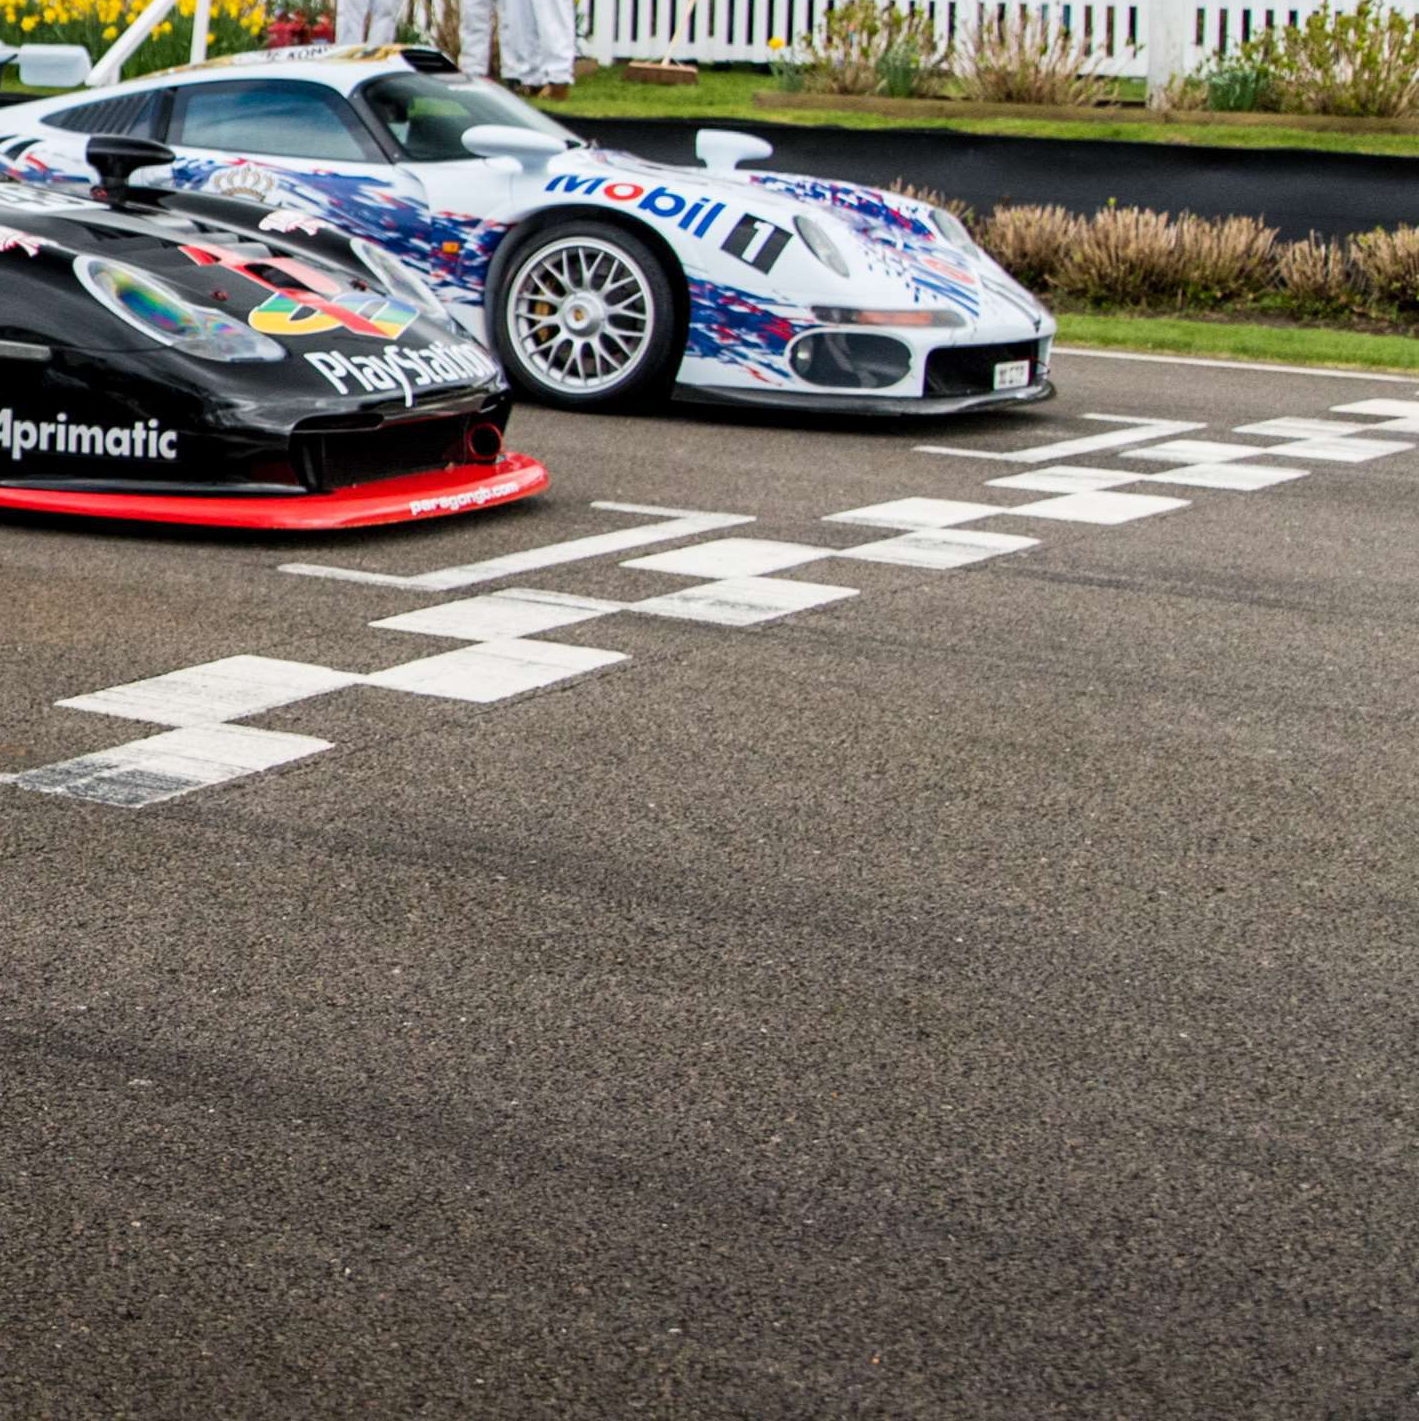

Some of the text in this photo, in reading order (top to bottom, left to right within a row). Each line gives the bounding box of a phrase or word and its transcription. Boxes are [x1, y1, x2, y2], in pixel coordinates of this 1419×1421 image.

[544, 174, 727, 240] Mobil
[303, 340, 498, 408] PlayStation
[409, 481, 520, 515] paragongb.com
